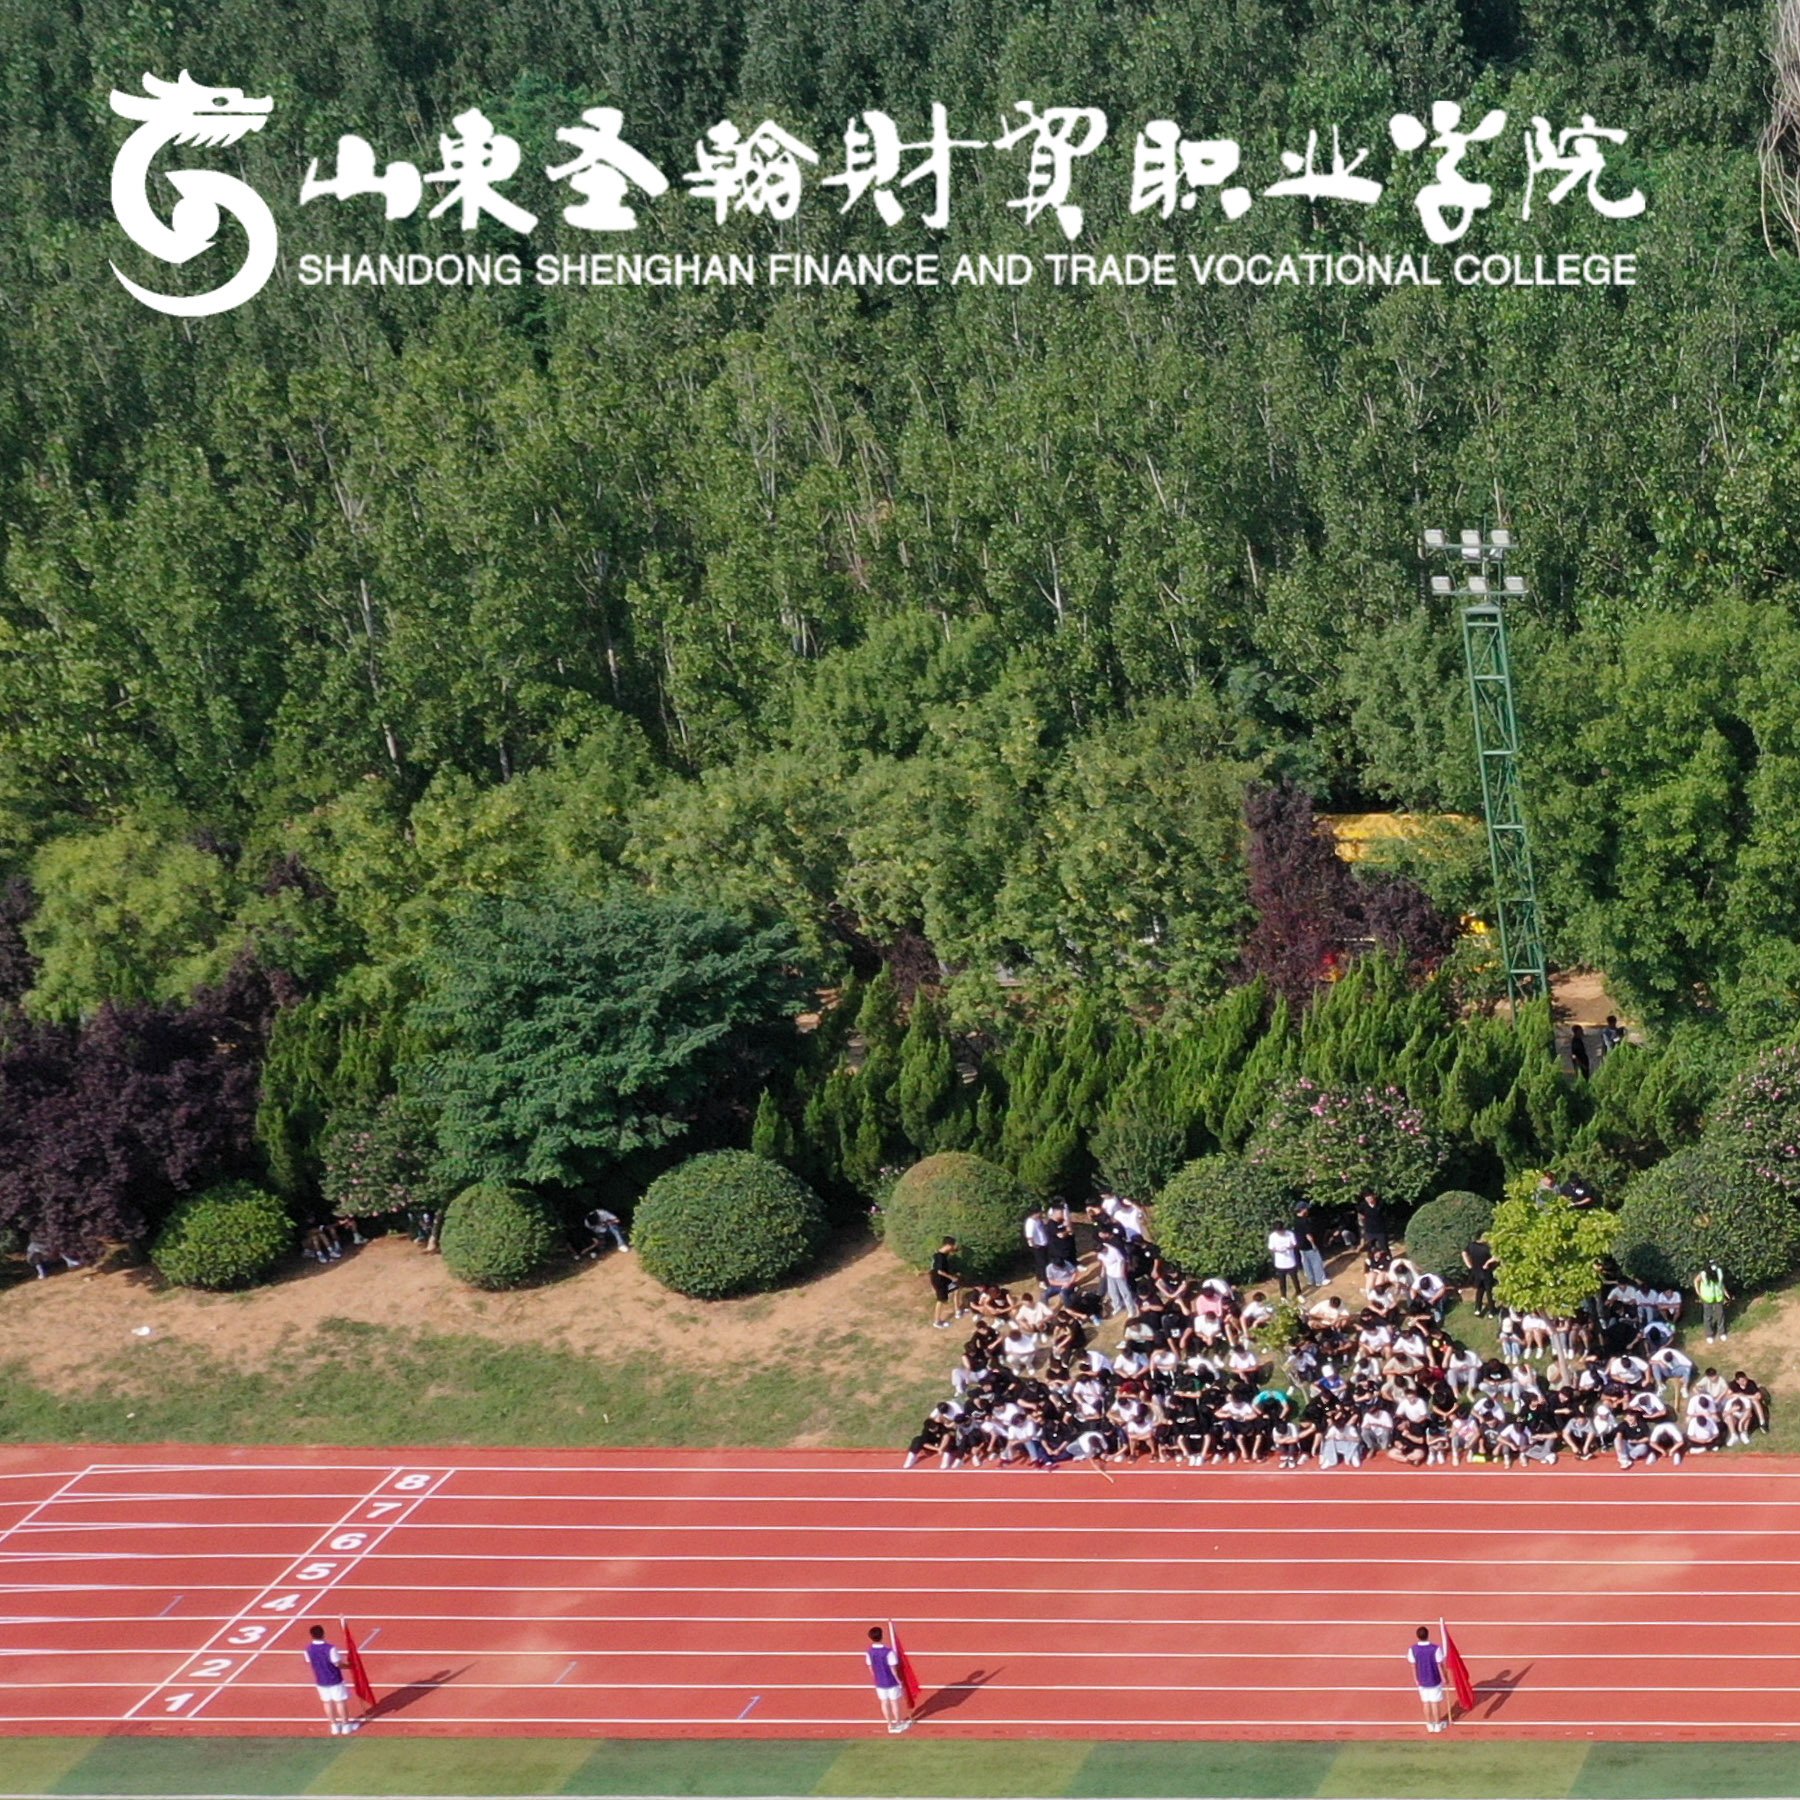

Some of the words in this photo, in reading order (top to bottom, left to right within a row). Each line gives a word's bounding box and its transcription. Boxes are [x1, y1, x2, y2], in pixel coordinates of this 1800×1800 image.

[394, 1474, 431, 1490] 8
[366, 1502, 402, 1518] 7
[330, 1533, 367, 1550] 6
[296, 1562, 337, 1580] 5
[261, 1593, 300, 1611] 4
[228, 1625, 266, 1644] 3
[189, 1658, 232, 1677] 2
[165, 1692, 194, 1712] 1
